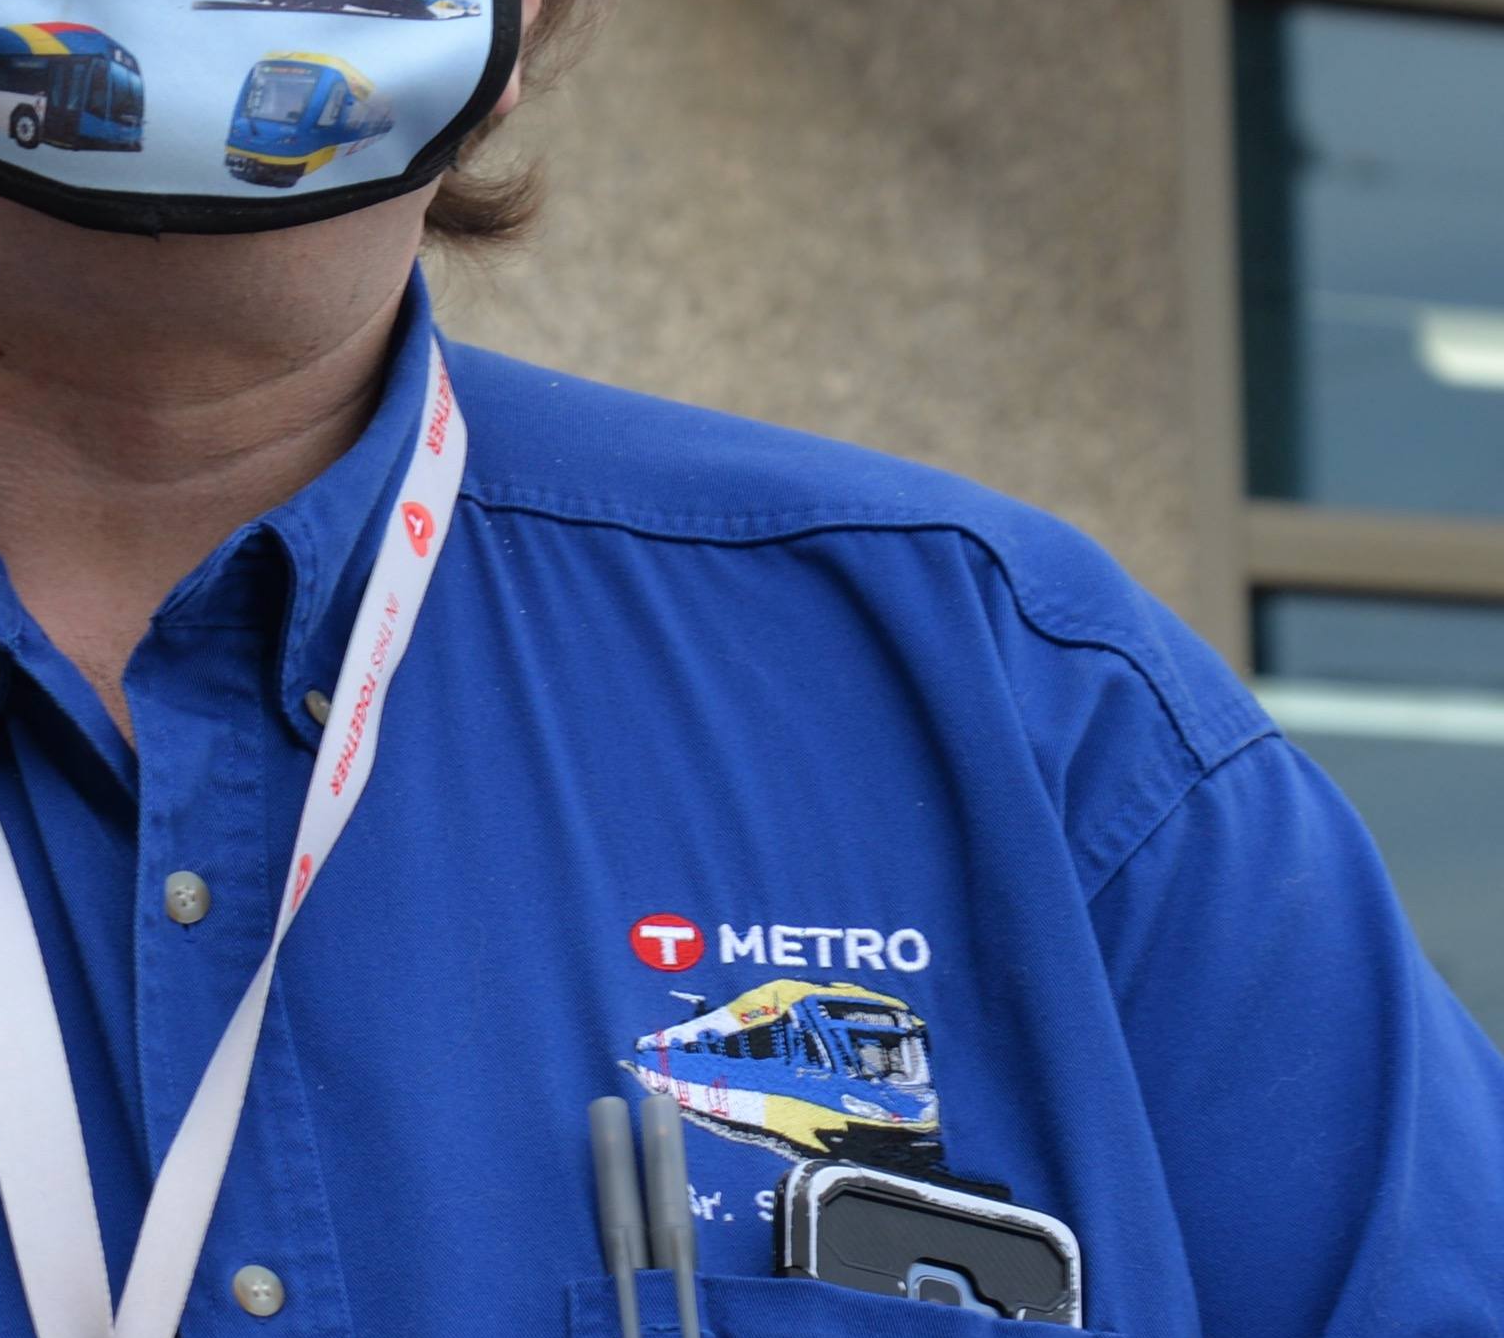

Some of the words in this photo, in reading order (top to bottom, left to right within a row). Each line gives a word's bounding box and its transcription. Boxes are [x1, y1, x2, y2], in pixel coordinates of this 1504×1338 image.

[330, 672, 378, 797] TOGETHER
[639, 925, 695, 965] T
[718, 923, 931, 973] METRO
